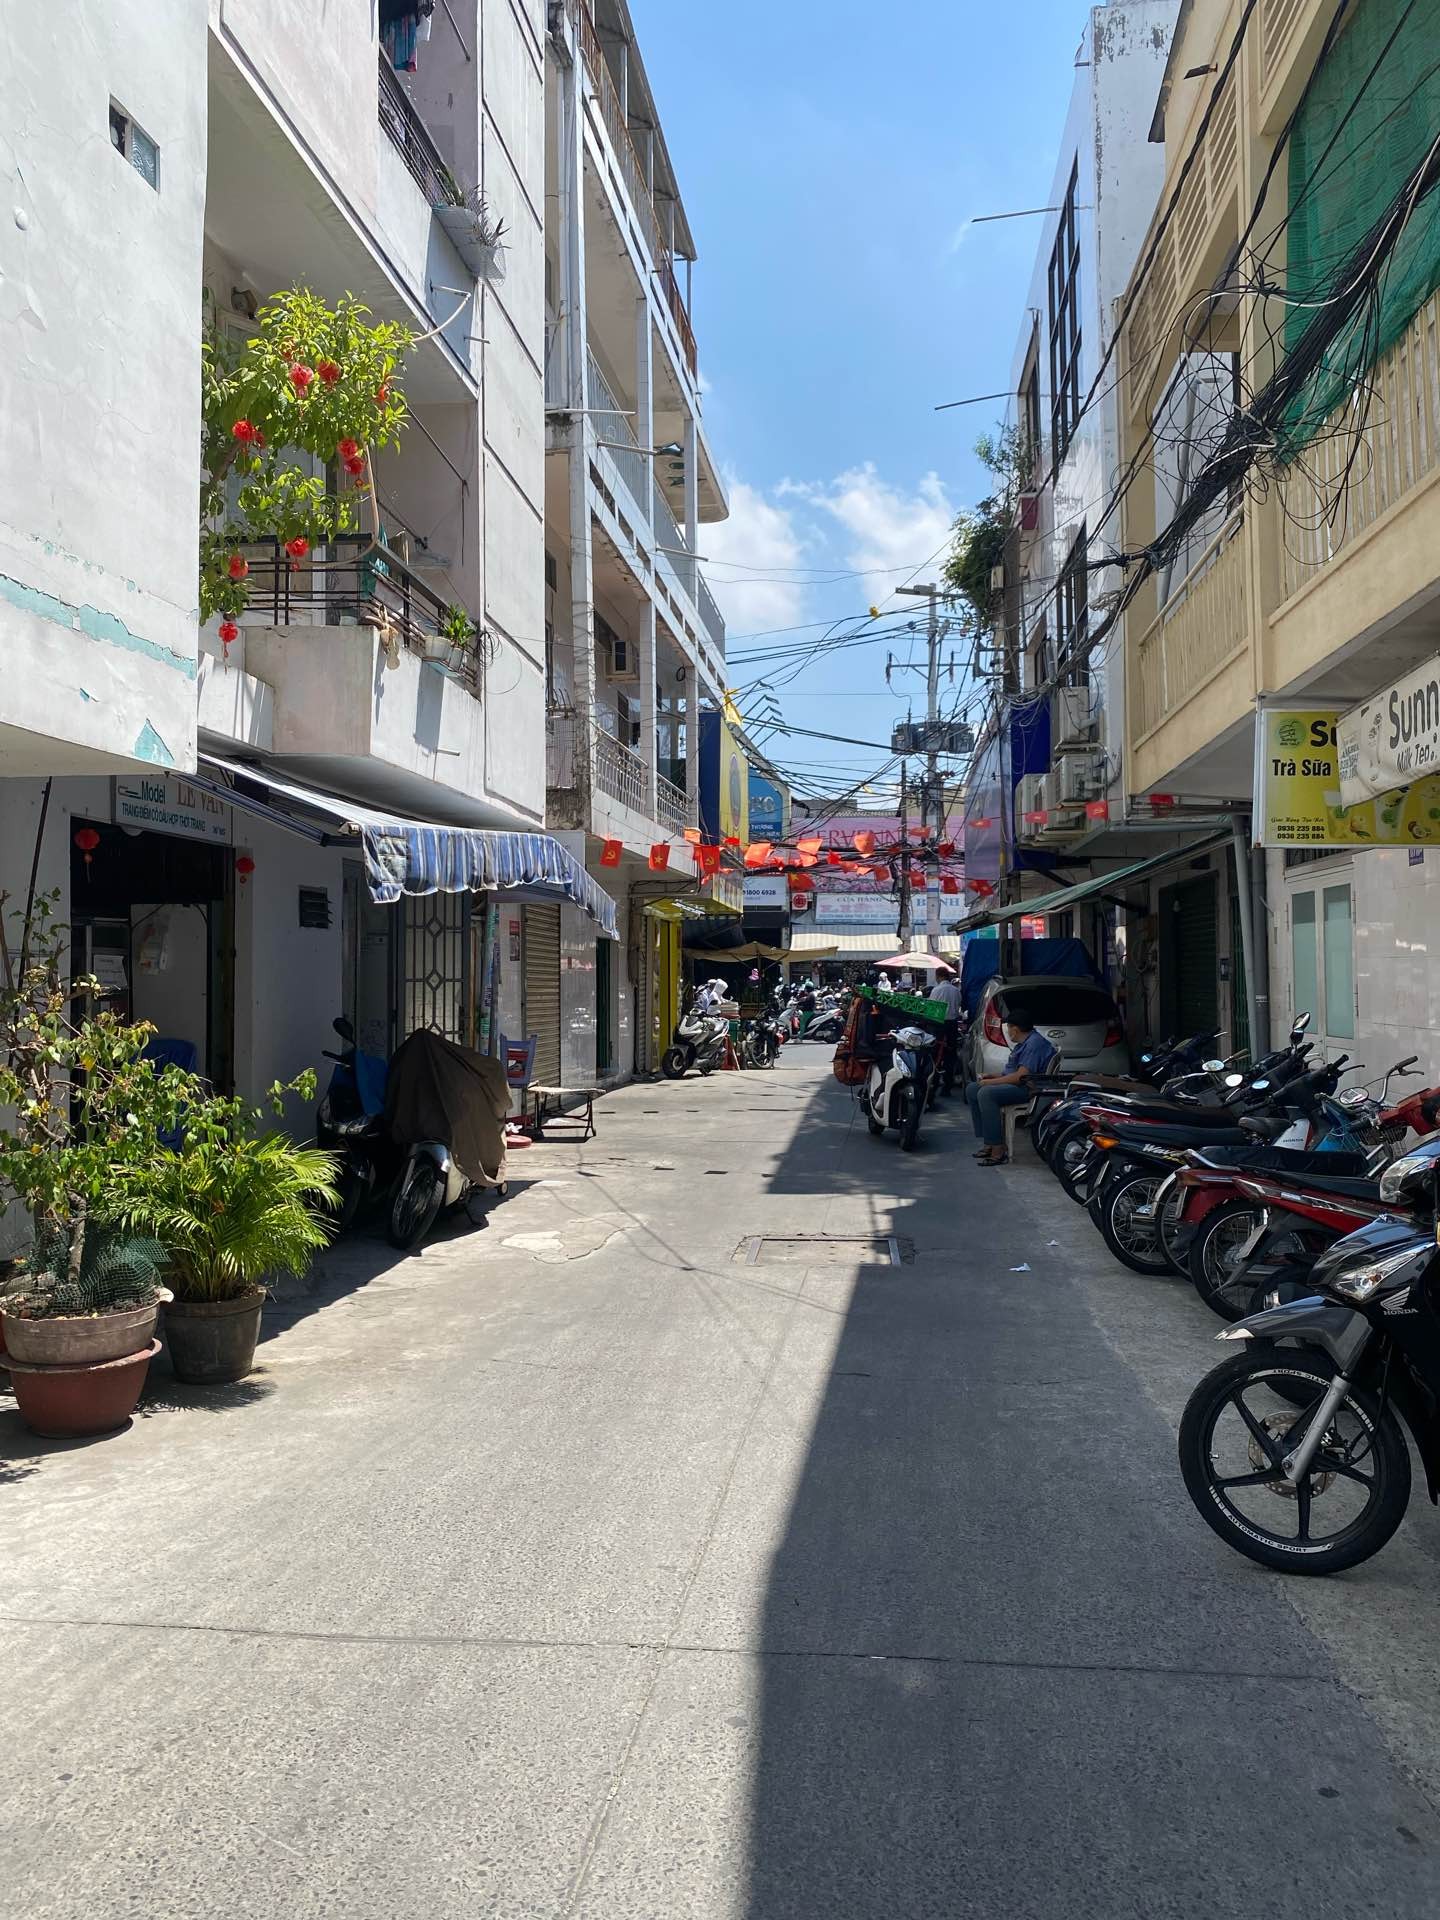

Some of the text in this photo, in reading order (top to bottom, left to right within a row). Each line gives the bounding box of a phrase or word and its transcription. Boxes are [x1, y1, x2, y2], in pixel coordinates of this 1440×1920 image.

[1272, 759, 1331, 776] Trà Sữa
[141, 781, 166, 804] Model
[1383, 1308, 1418, 1316] HONDA
[1228, 1514, 1307, 1554] AUTOMATIC SPORT
